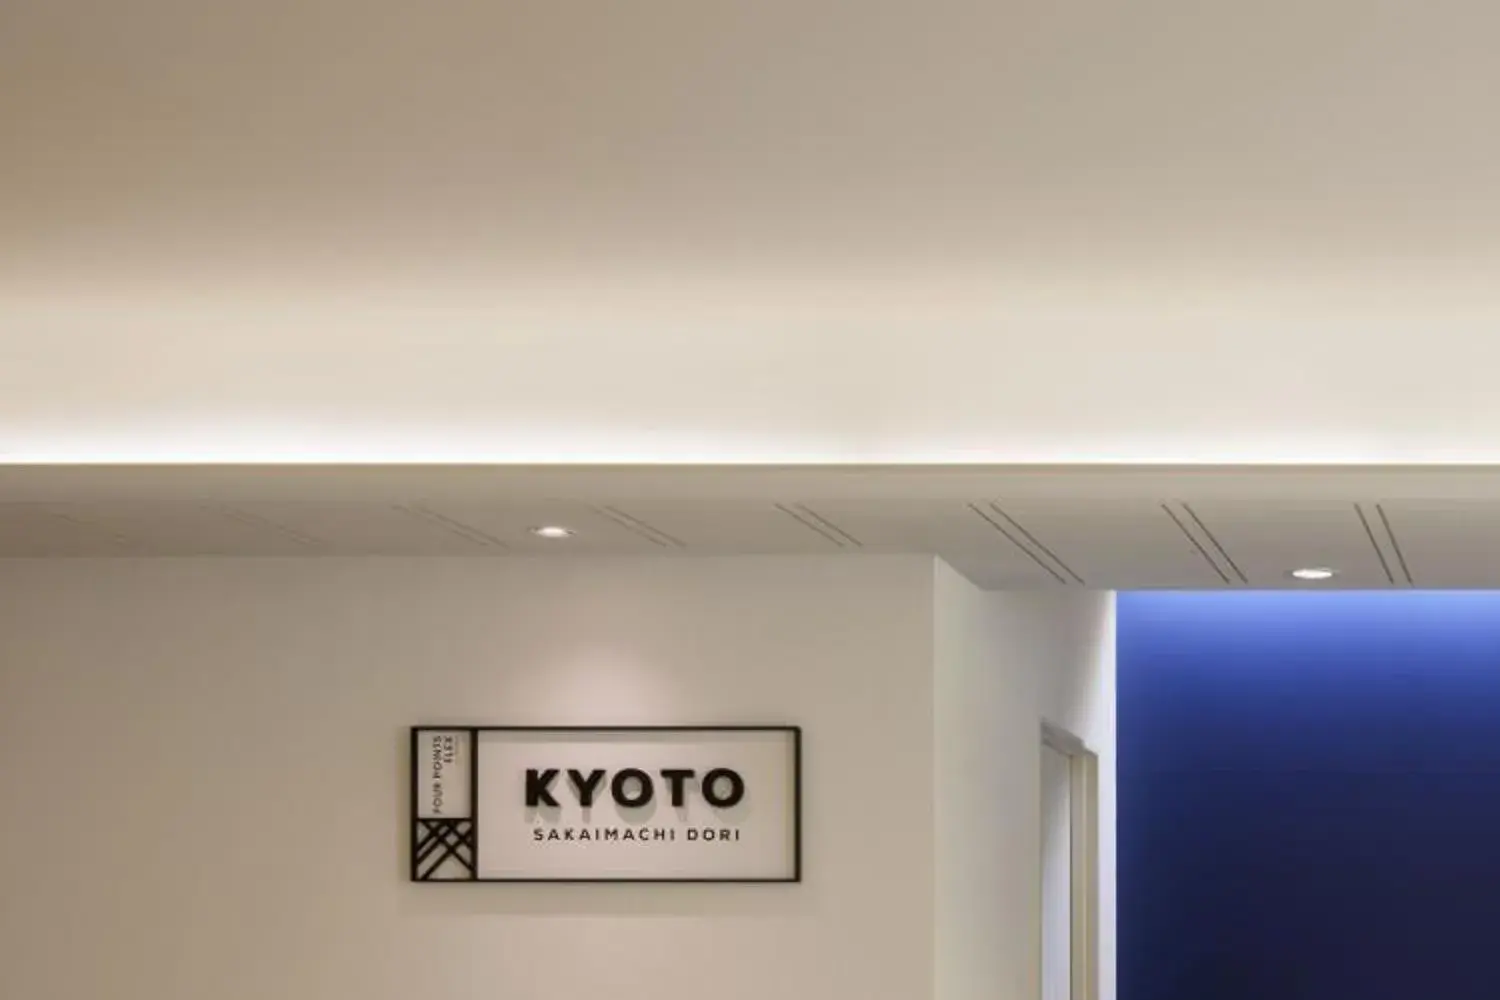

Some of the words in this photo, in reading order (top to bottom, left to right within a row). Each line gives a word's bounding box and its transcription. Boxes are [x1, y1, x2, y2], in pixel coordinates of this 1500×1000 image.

[432, 735, 442, 779] POINTS
[432, 783, 443, 814] FOUR
[525, 768, 744, 808] KYOTO
[533, 828, 676, 841] SAKAIMACHI
[688, 828, 740, 841] DORI
